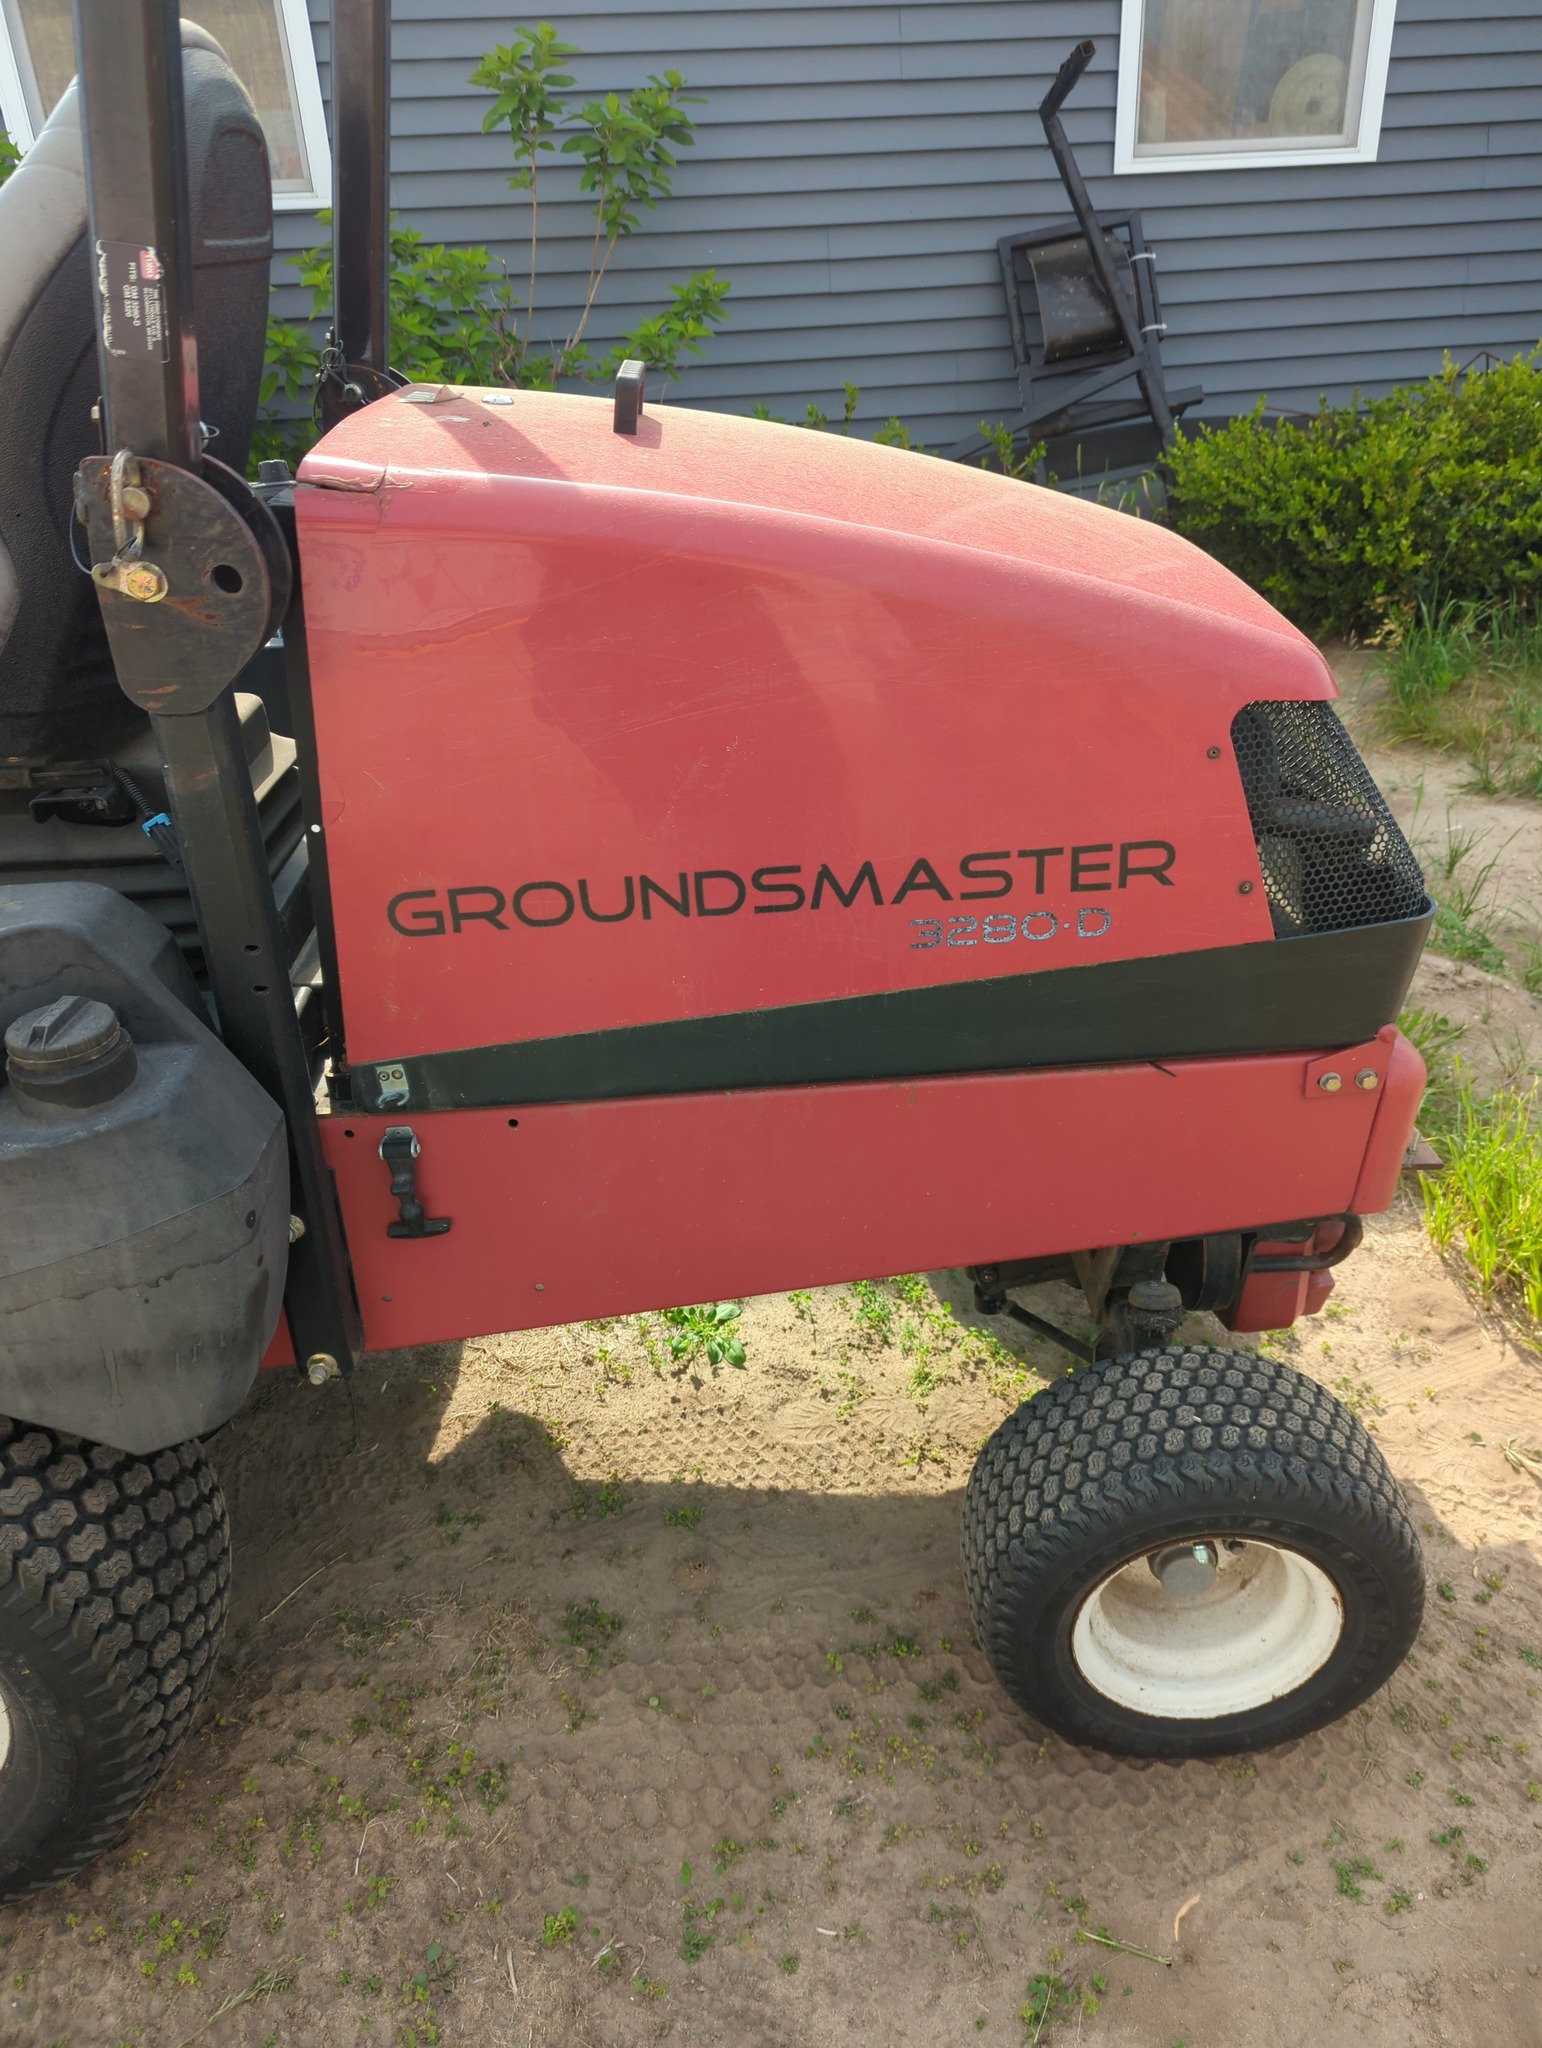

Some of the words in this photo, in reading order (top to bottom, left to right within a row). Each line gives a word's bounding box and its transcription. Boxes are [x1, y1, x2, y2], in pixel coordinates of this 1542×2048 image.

[128, 262, 137, 283] FITS:
[123, 285, 131, 298] GM
[130, 285, 139, 299] GM
[387, 839, 1177, 938] GROUNDSMASTER
